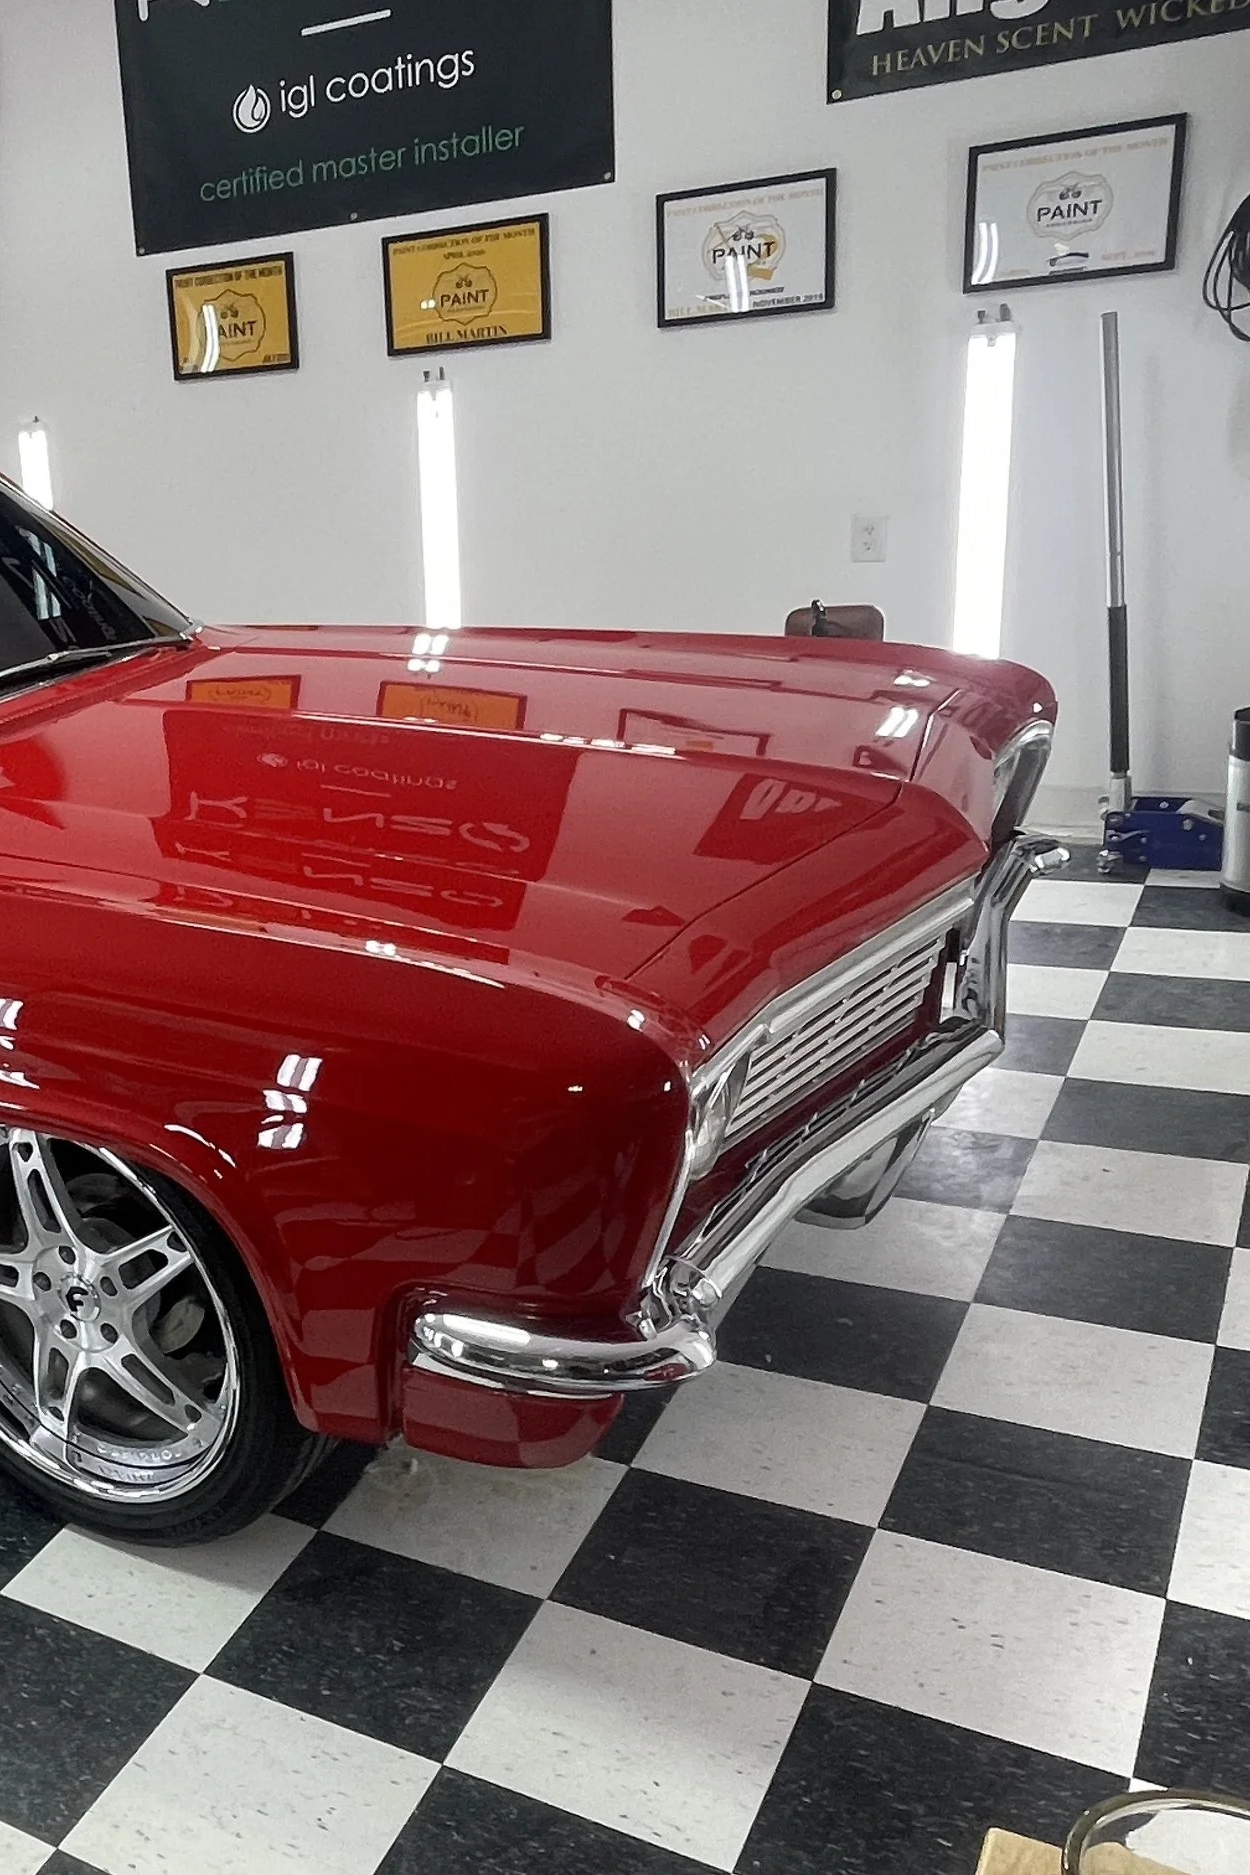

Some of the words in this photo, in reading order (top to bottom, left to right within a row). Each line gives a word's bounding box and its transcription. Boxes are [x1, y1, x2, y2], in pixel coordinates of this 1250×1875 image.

[871, 35, 985, 76] HEAVEN
[995, 14, 1098, 54] SCENT
[279, 75, 316, 118] igl
[325, 50, 475, 102] coatings
[200, 160, 304, 202] certified
[311, 146, 407, 184] master
[413, 125, 525, 165] installer
[1037, 200, 1102, 221] PAINT
[712, 241, 775, 264] PAINT
[440, 289, 489, 308] PAINT
[218, 320, 257, 339] AINT
[426, 329, 454, 344] BILL
[457, 325, 508, 340] MARTIN
